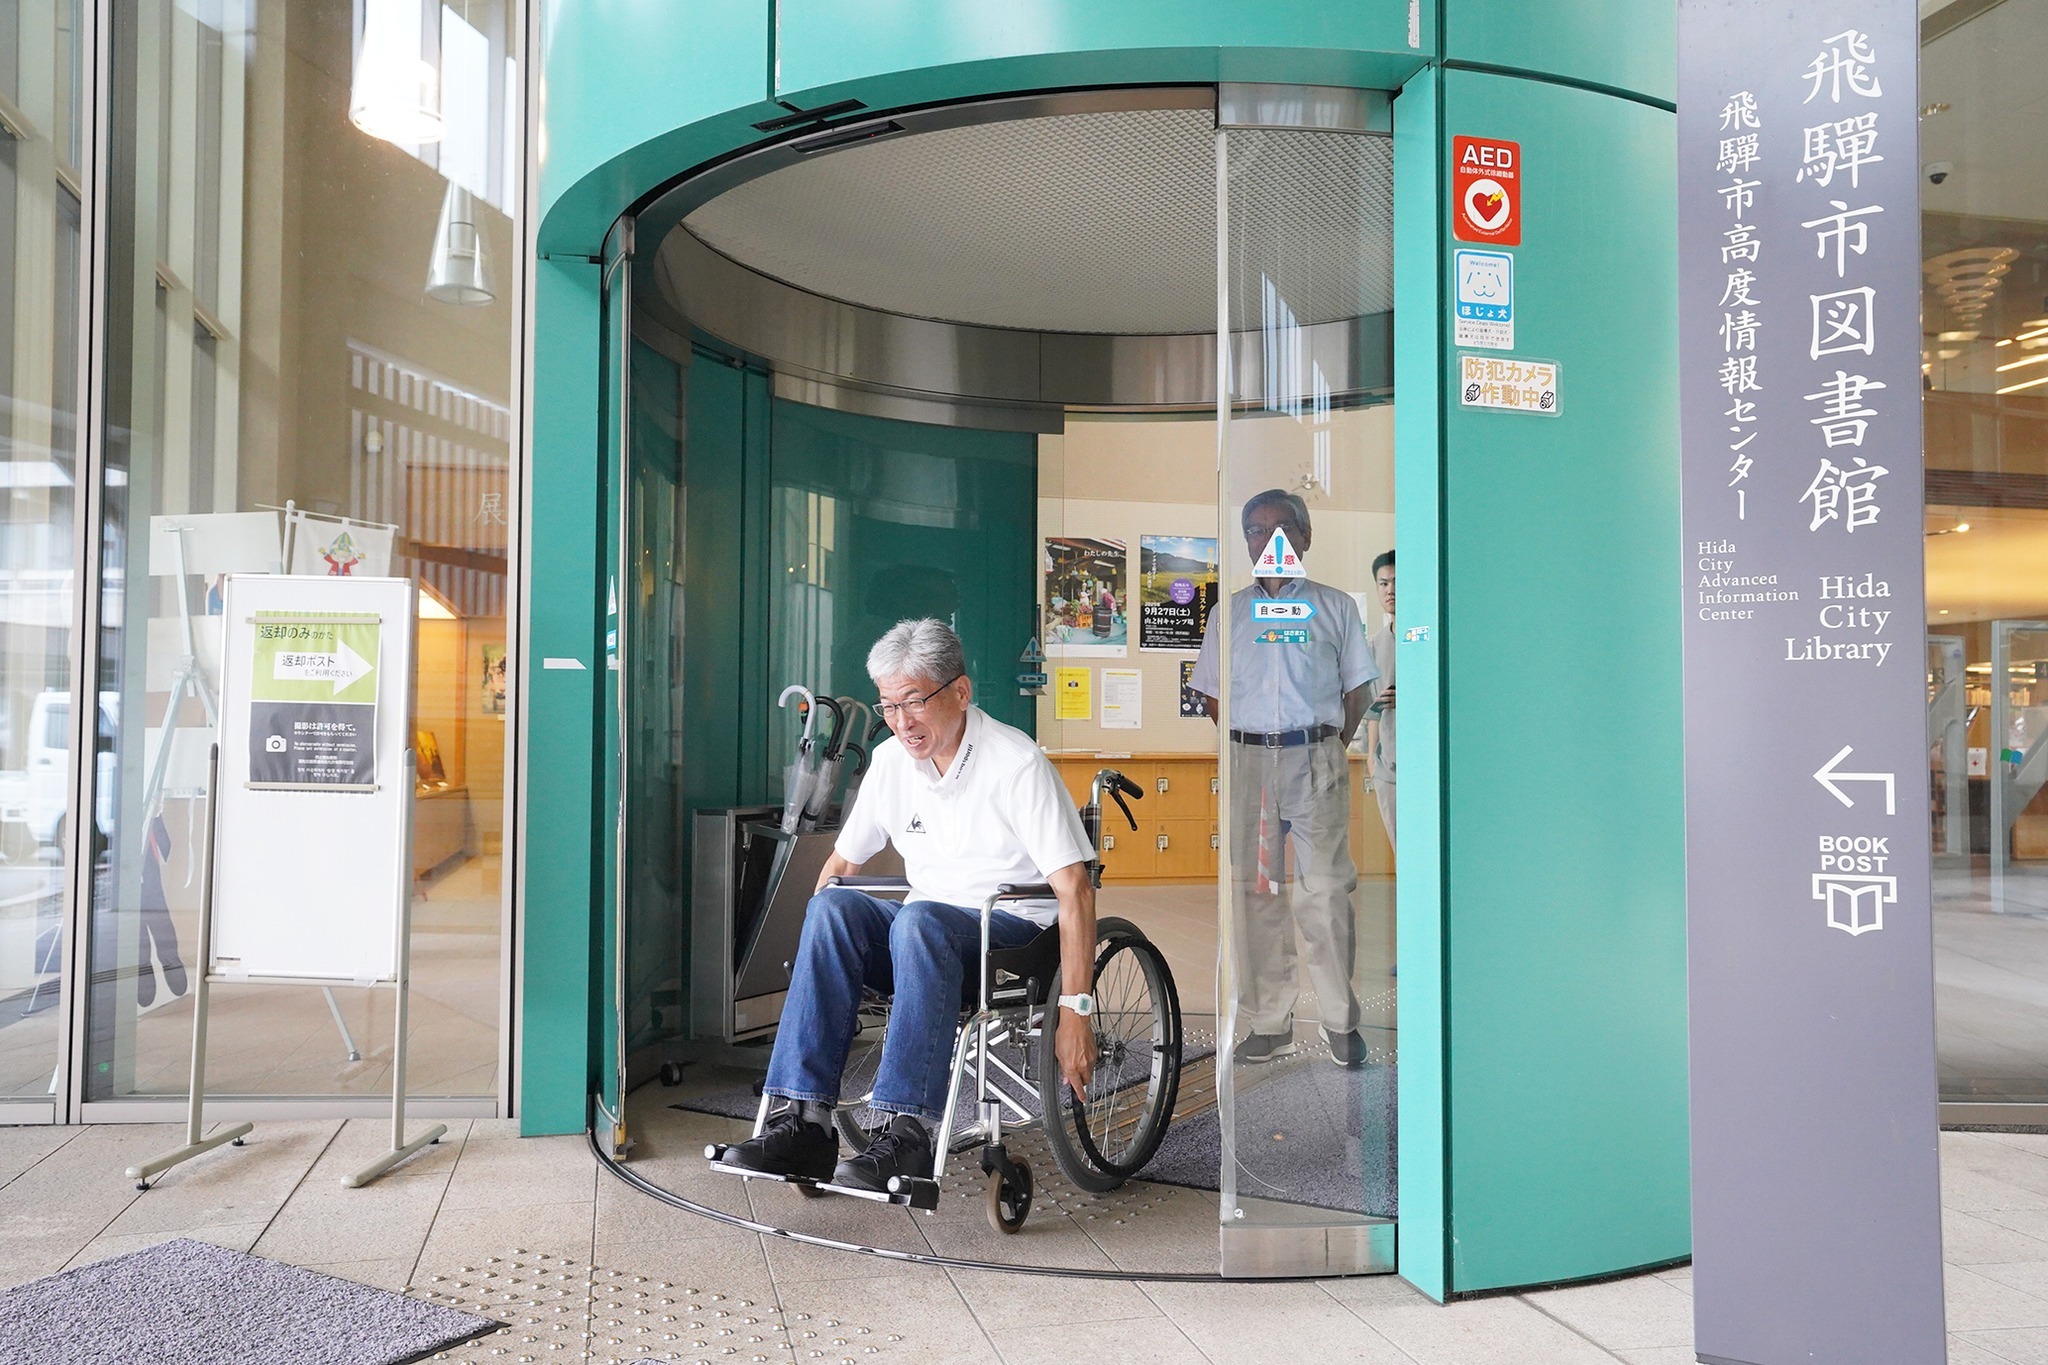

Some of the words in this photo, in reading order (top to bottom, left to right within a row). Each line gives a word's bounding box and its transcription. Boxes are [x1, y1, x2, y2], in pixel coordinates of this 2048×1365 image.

[1462, 144, 1513, 169] AED
[1469, 260, 1500, 268] Welcome!
[1461, 305, 1508, 319] ほじょ犬
[1465, 358, 1553, 387] 防犯カメラ
[1481, 382, 1540, 408] 作動中
[474, 493, 507, 525] 展
[1698, 540, 1736, 555] Hida
[1698, 558, 1733, 574] City
[1819, 573, 1891, 600] Hida
[1699, 589, 1800, 604] Information
[1144, 607, 1191, 616] 9月27日(土)
[1699, 607, 1754, 621] Center
[1819, 604, 1891, 635] City
[260, 625, 333, 640] 返却のみのかた
[1784, 635, 1893, 667] Library
[281, 654, 335, 668] 返却ポスト
[304, 669, 353, 678] をご利用ください
[1819, 835, 1890, 854] BOOK
[1821, 854, 1888, 873] POST
